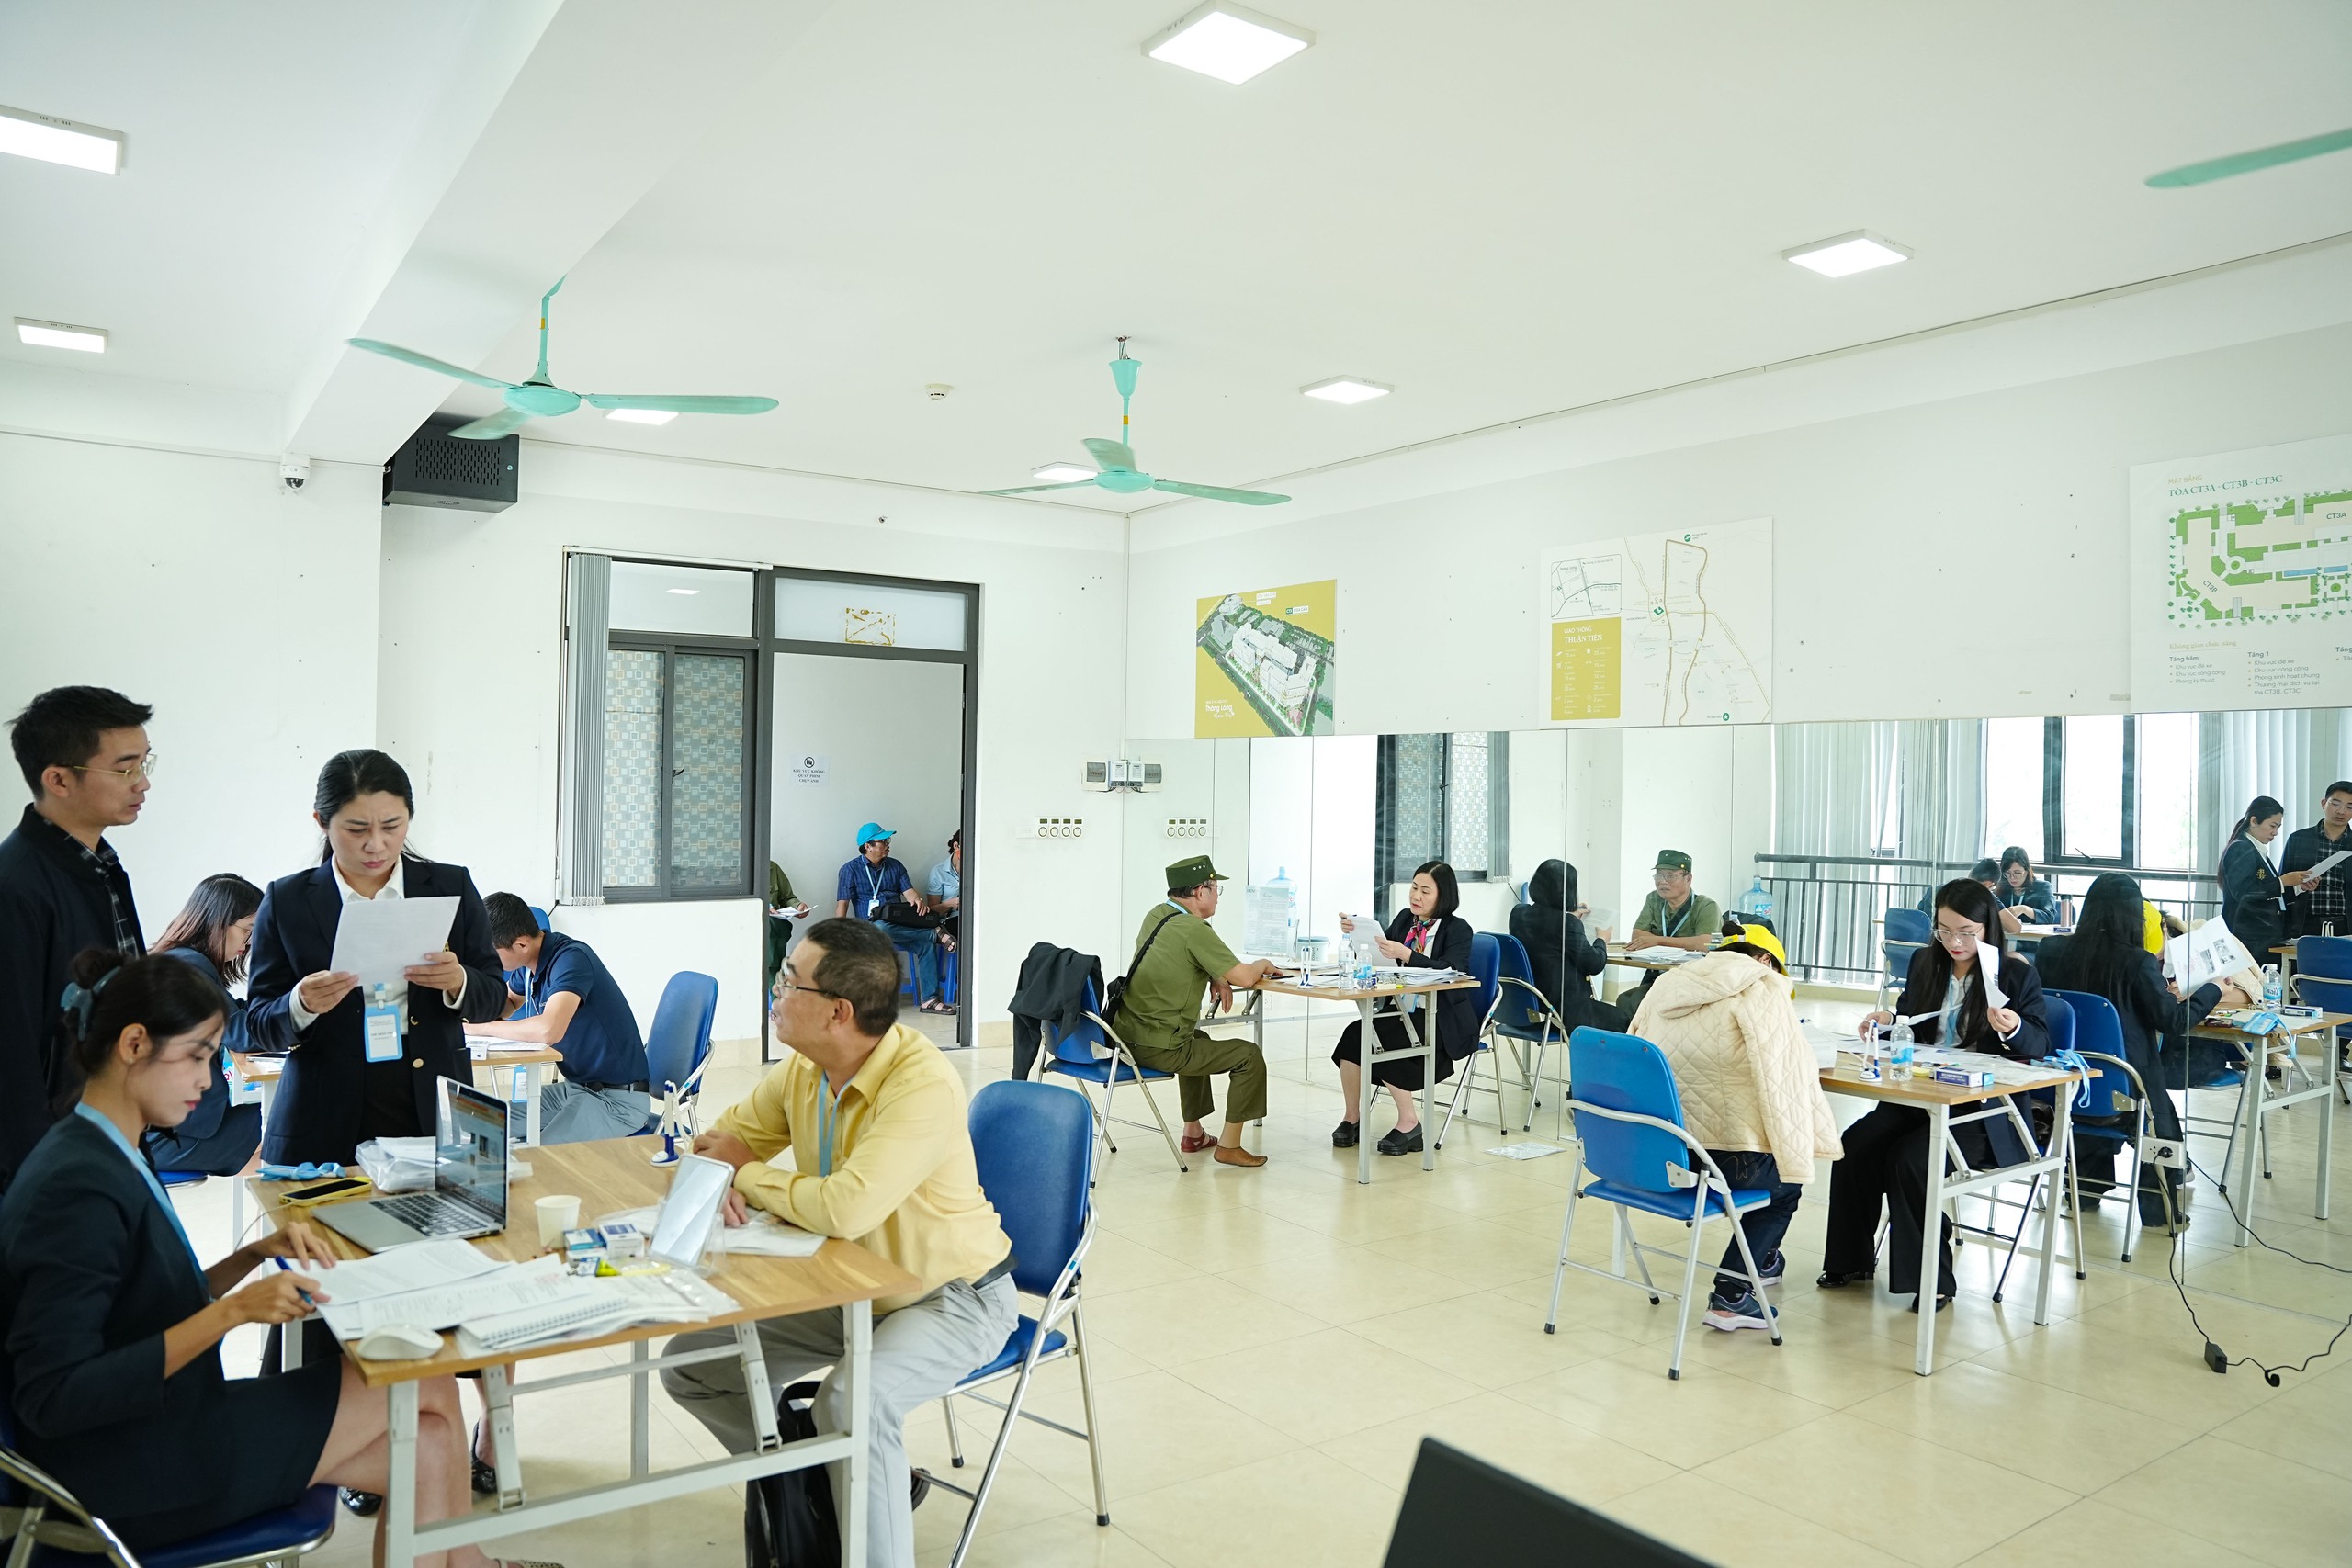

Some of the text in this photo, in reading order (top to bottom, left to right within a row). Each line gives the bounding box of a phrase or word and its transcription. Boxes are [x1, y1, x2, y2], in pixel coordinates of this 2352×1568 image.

[2190, 485, 2215, 494] CT3A
[2222, 479, 2248, 490] CT3B
[2255, 475, 2283, 485] CT3C
[2326, 512, 2346, 520] CT3A
[2203, 580, 2218, 593] CT3B
